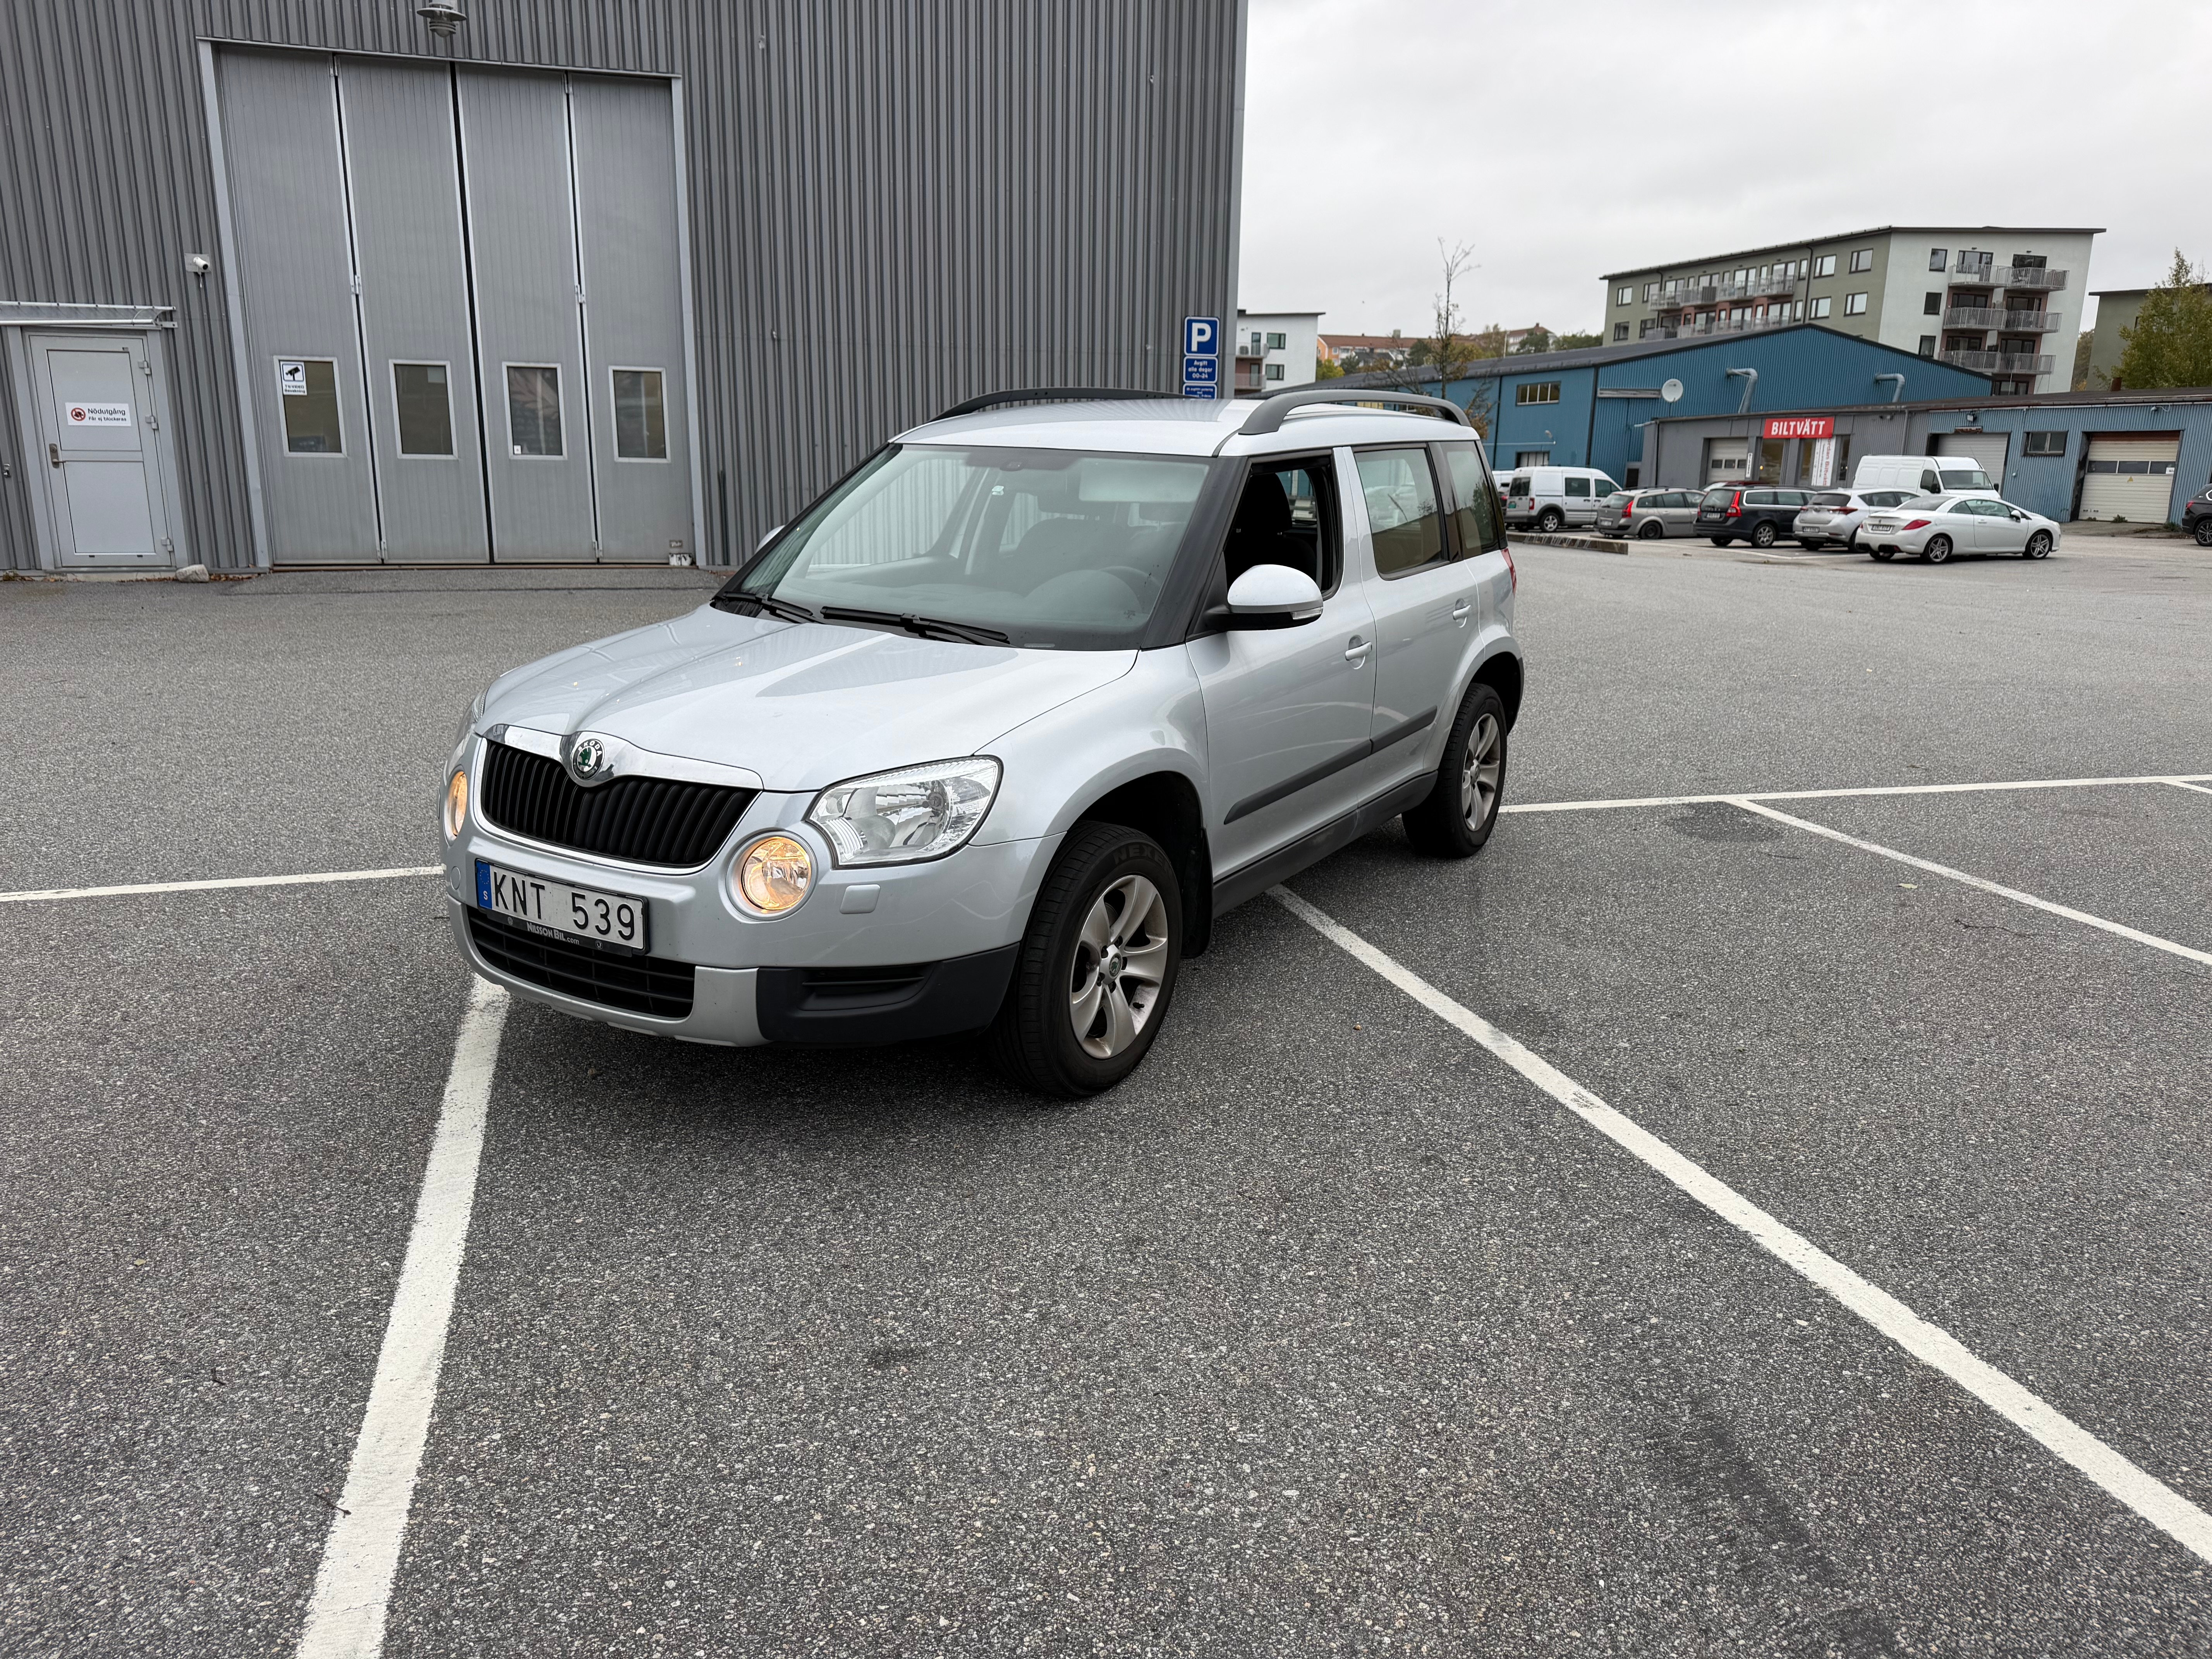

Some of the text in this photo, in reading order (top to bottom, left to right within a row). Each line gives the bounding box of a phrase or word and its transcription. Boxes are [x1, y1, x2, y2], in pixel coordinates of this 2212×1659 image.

[1191, 322, 1211, 352] P
[88, 408, 125, 416] Nödutgång
[1771, 419, 1825, 435] BILTVÄTT
[483, 891, 488, 900] S
[494, 872, 634, 941] KNT 539
